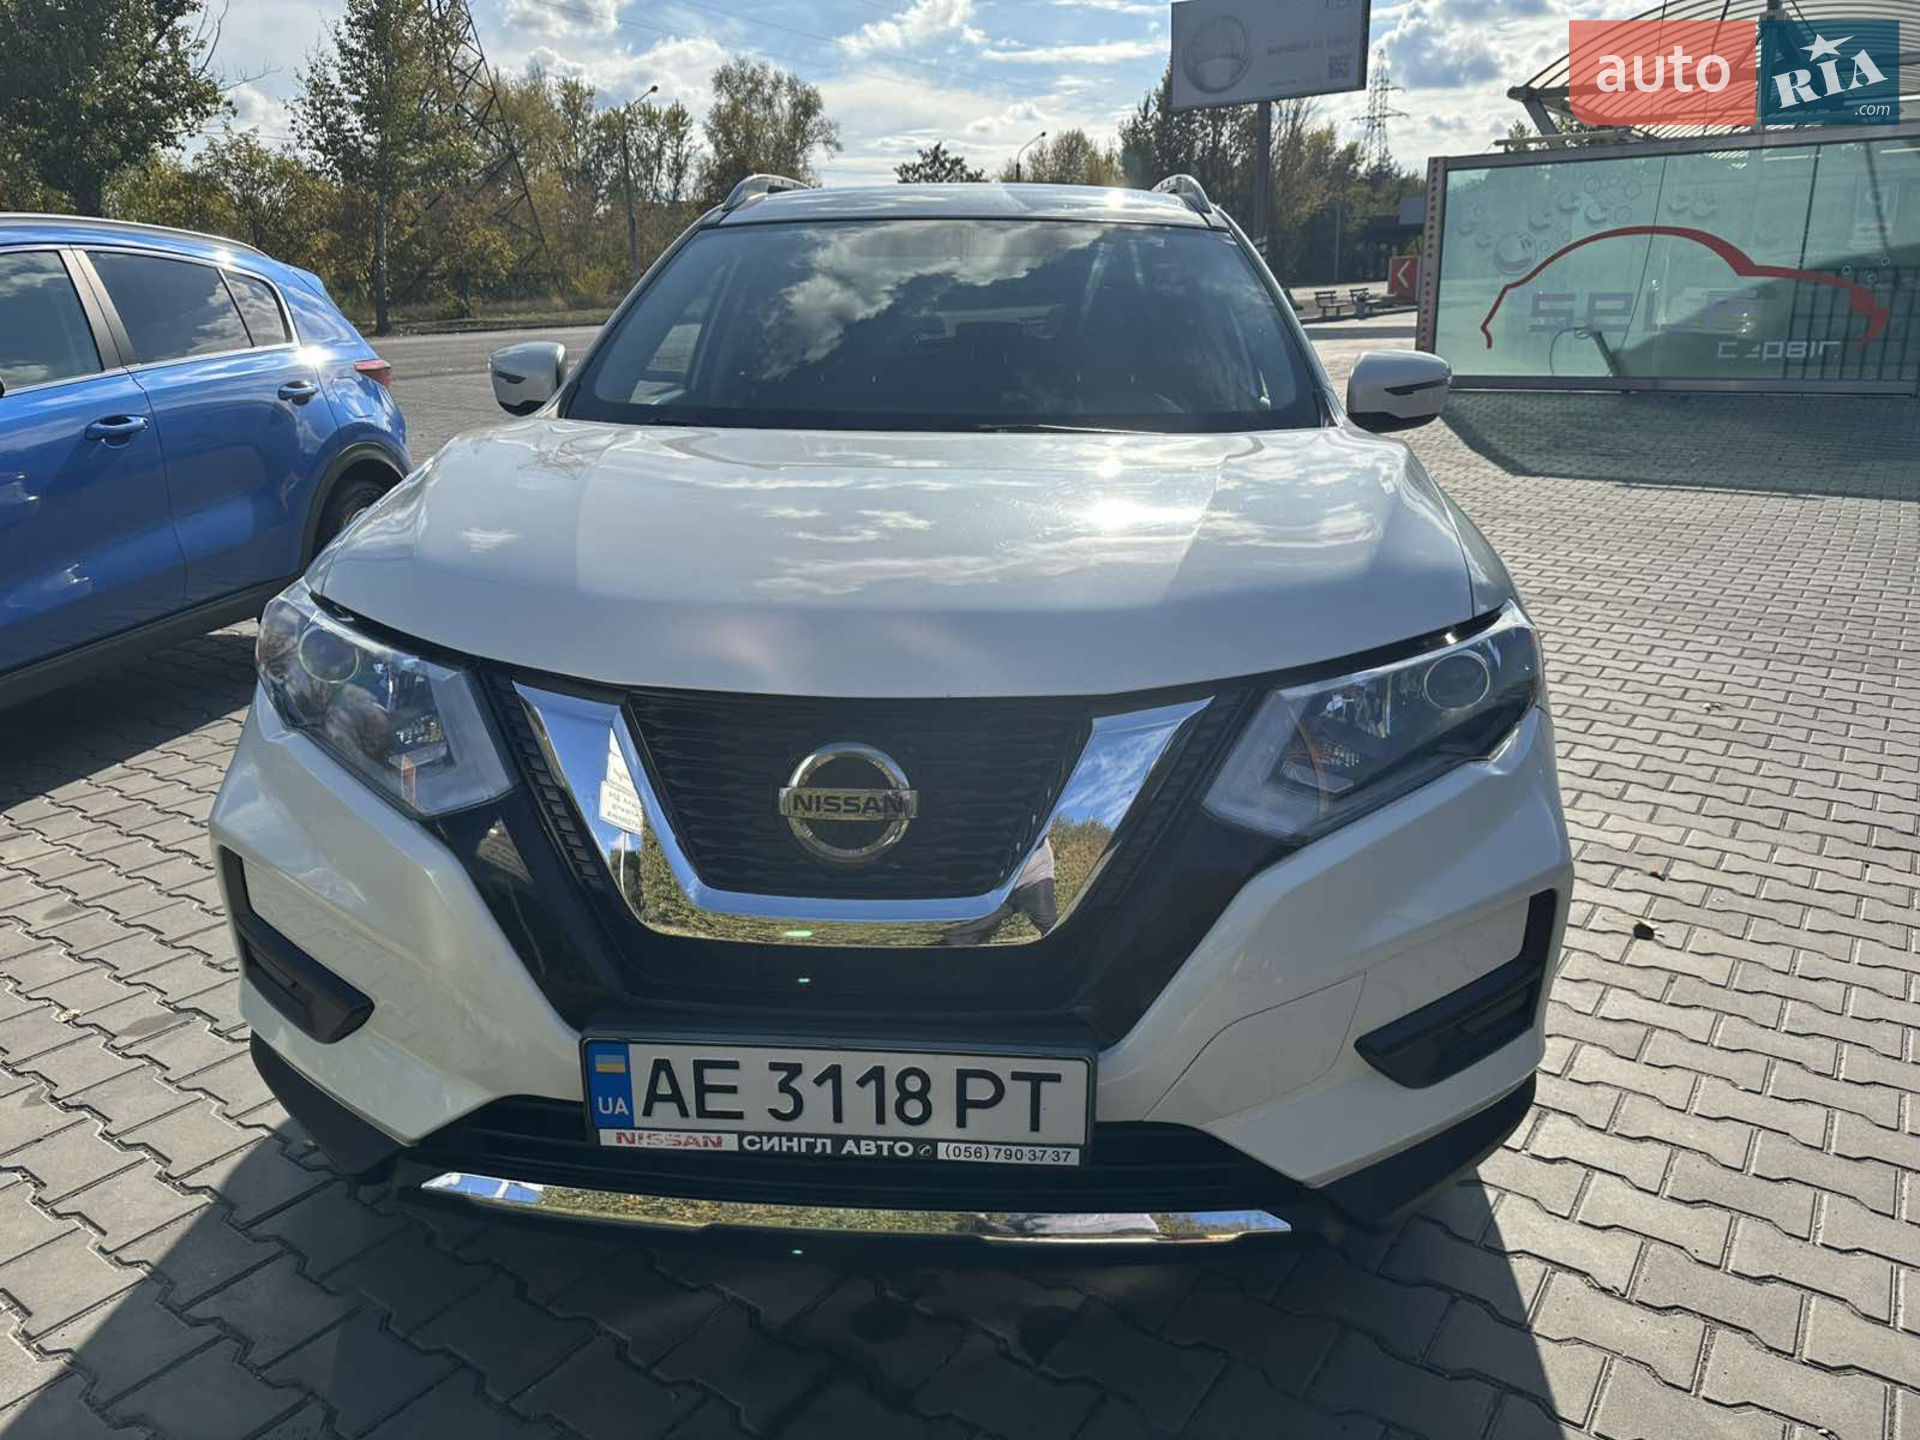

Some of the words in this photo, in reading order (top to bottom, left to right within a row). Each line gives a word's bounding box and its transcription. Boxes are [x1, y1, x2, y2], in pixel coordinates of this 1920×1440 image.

[793, 793, 903, 815] NISSAN
[641, 1058, 745, 1121] AE
[766, 1061, 933, 1126] 3118
[954, 1067, 1062, 1133] PT
[598, 1097, 630, 1117] UA
[615, 1131, 724, 1149] NISSAN
[742, 1135, 832, 1154] СИНГЛ
[840, 1139, 914, 1157] АВТО
